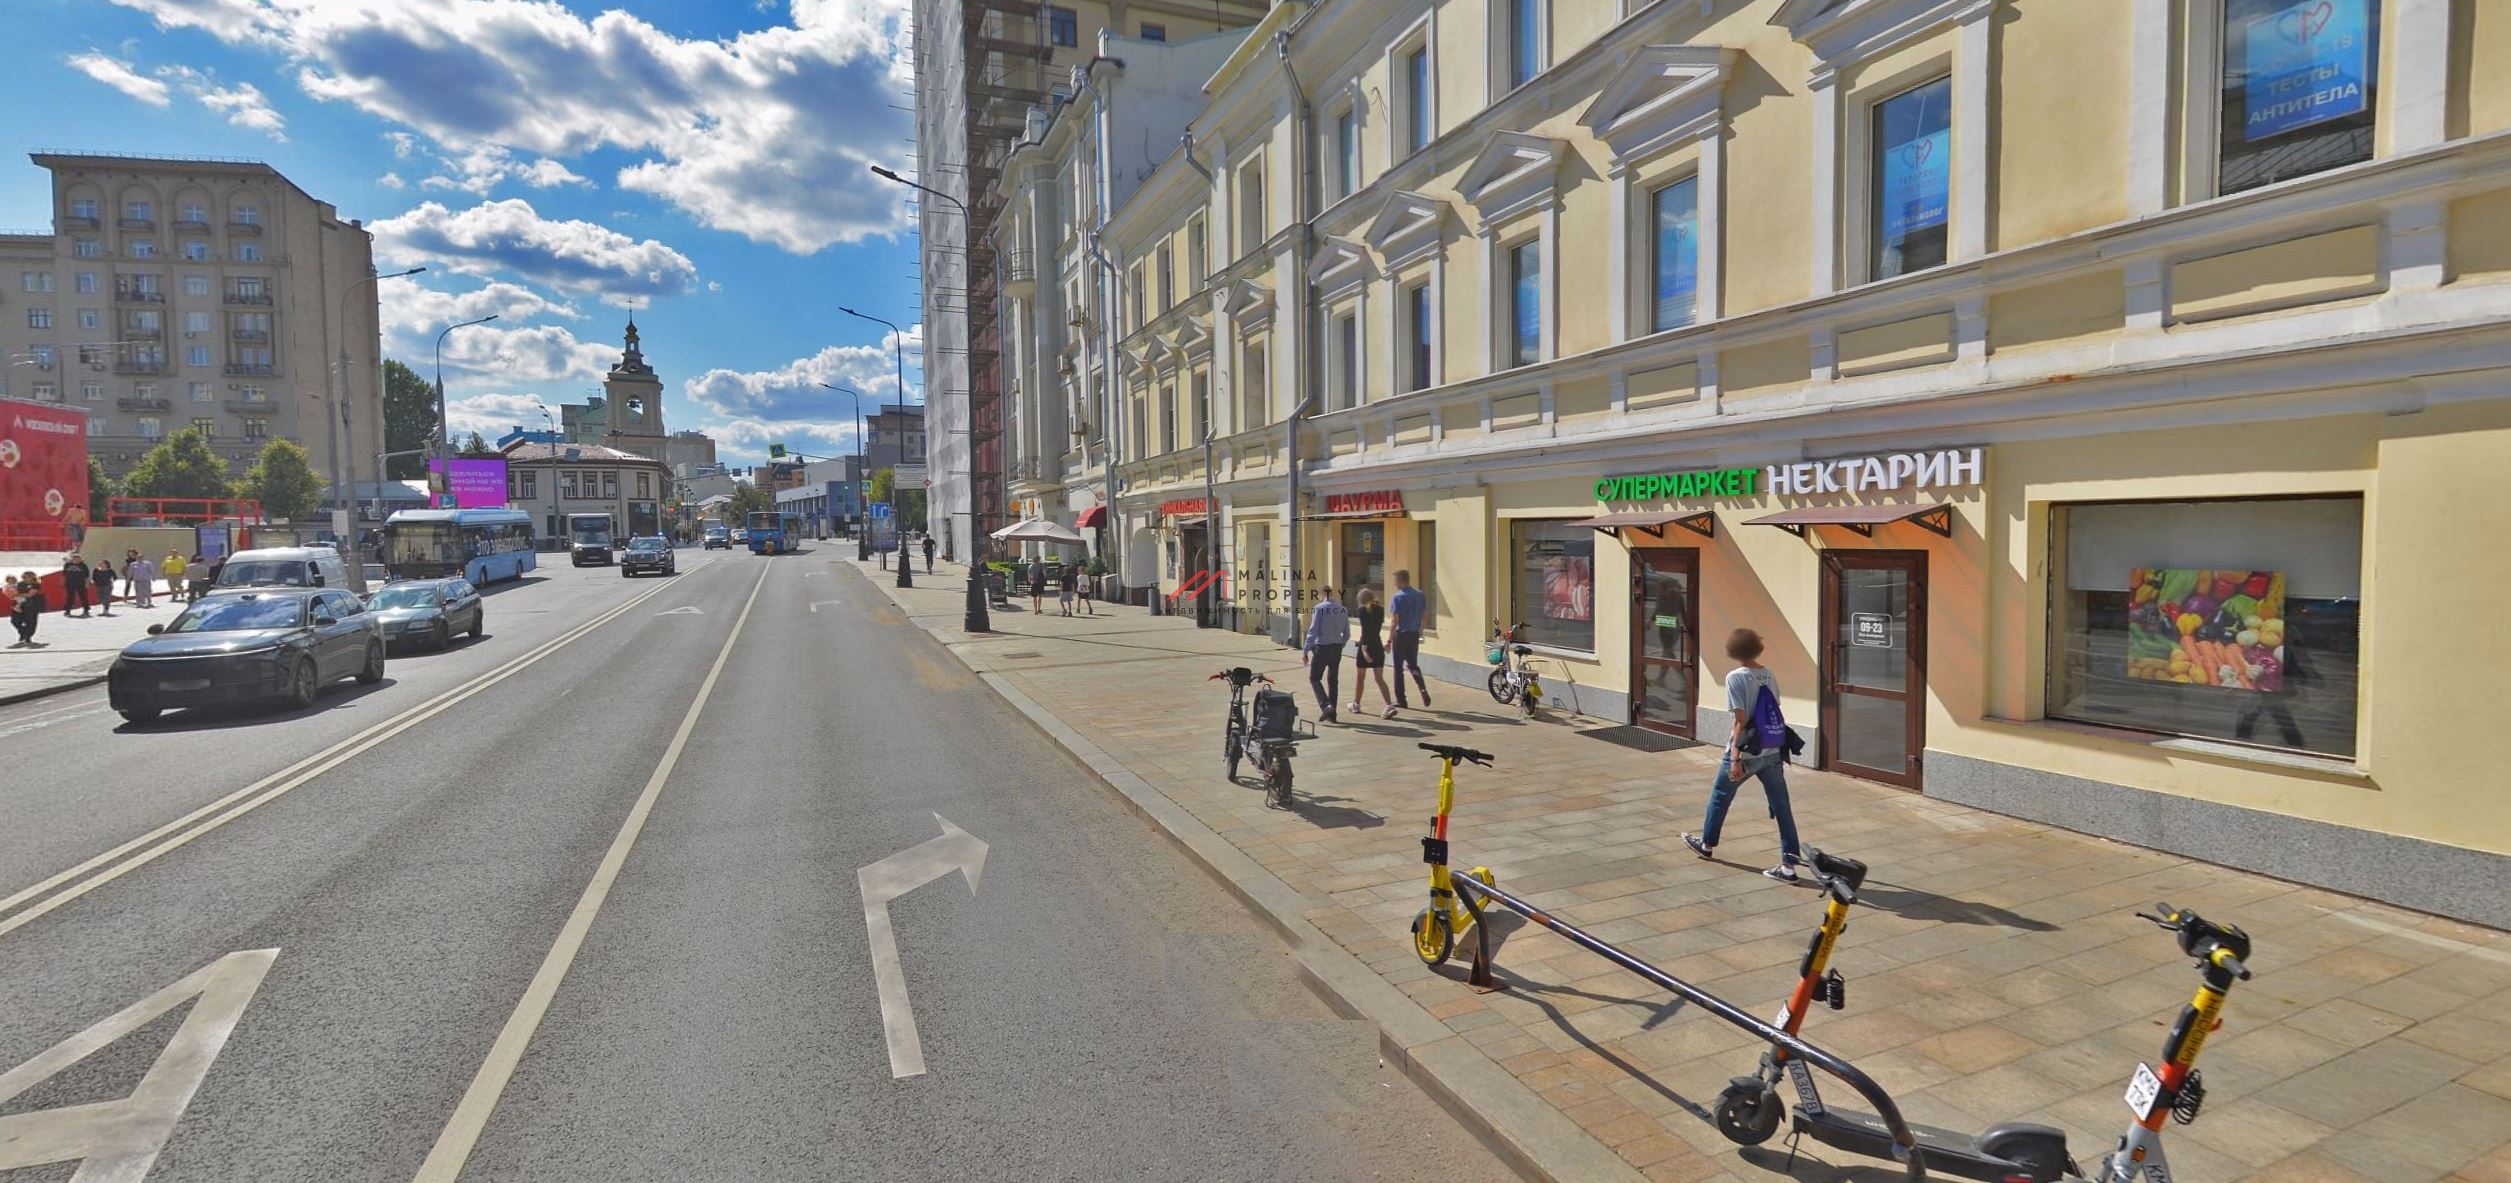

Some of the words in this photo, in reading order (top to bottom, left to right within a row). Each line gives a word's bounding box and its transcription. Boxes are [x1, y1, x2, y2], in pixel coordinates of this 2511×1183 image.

[2267, 63, 2339, 95] ТЕСТЫ
[2248, 82, 2359, 125] АНТИТЕЛА
[1594, 468, 1760, 500] СУПЕРМАРКЕТ
[1766, 449, 1981, 495] НЕКТАРИН
[1327, 489, 1404, 512] ШАУРМА
[1860, 621, 1883, 633] 09-23
[2180, 997, 2221, 1061] WHOOSH
